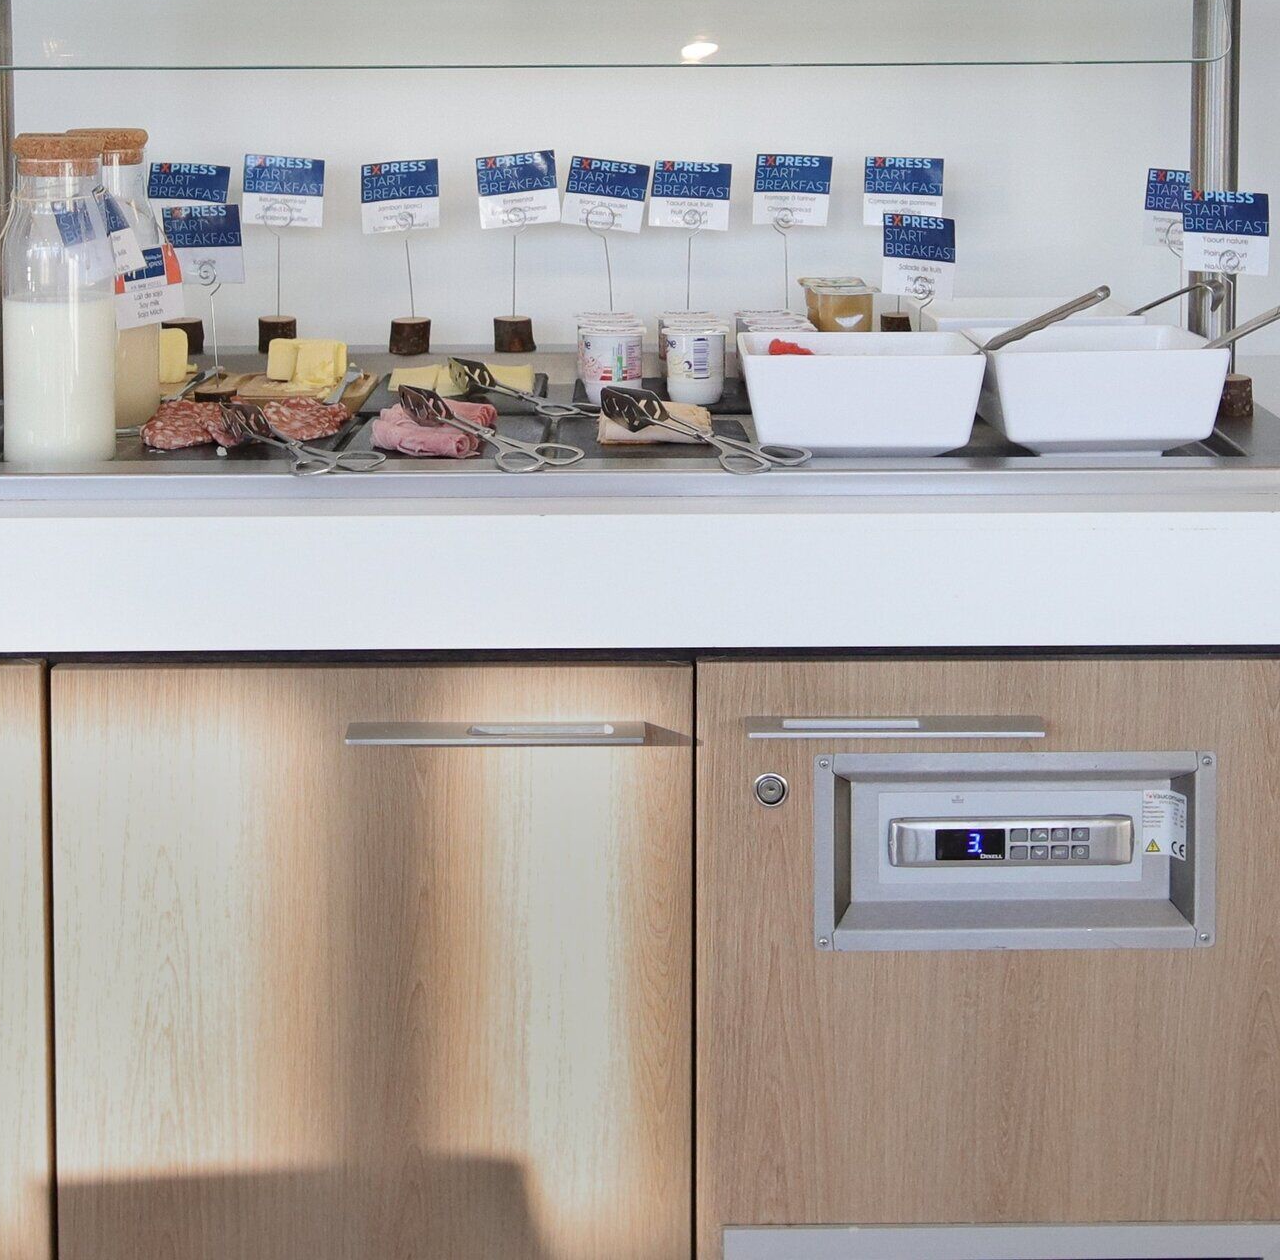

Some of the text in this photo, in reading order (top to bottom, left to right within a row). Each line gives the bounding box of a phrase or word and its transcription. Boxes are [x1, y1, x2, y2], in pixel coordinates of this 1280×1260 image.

[246, 155, 313, 169] EXPRESS
[363, 161, 426, 176] EXPRESS
[477, 153, 542, 170] EXPRESS
[572, 157, 637, 174] EXPRESS
[655, 160, 720, 173] EXPRESS
[758, 155, 820, 168] EXPRESS
[866, 156, 932, 169] EXPRESS
[151, 163, 217, 176] EXPRESS
[1149, 170, 1192, 184] EXPRE
[1183, 189, 1255, 204] EXPRESS
[885, 214, 945, 230] EXPRESS
